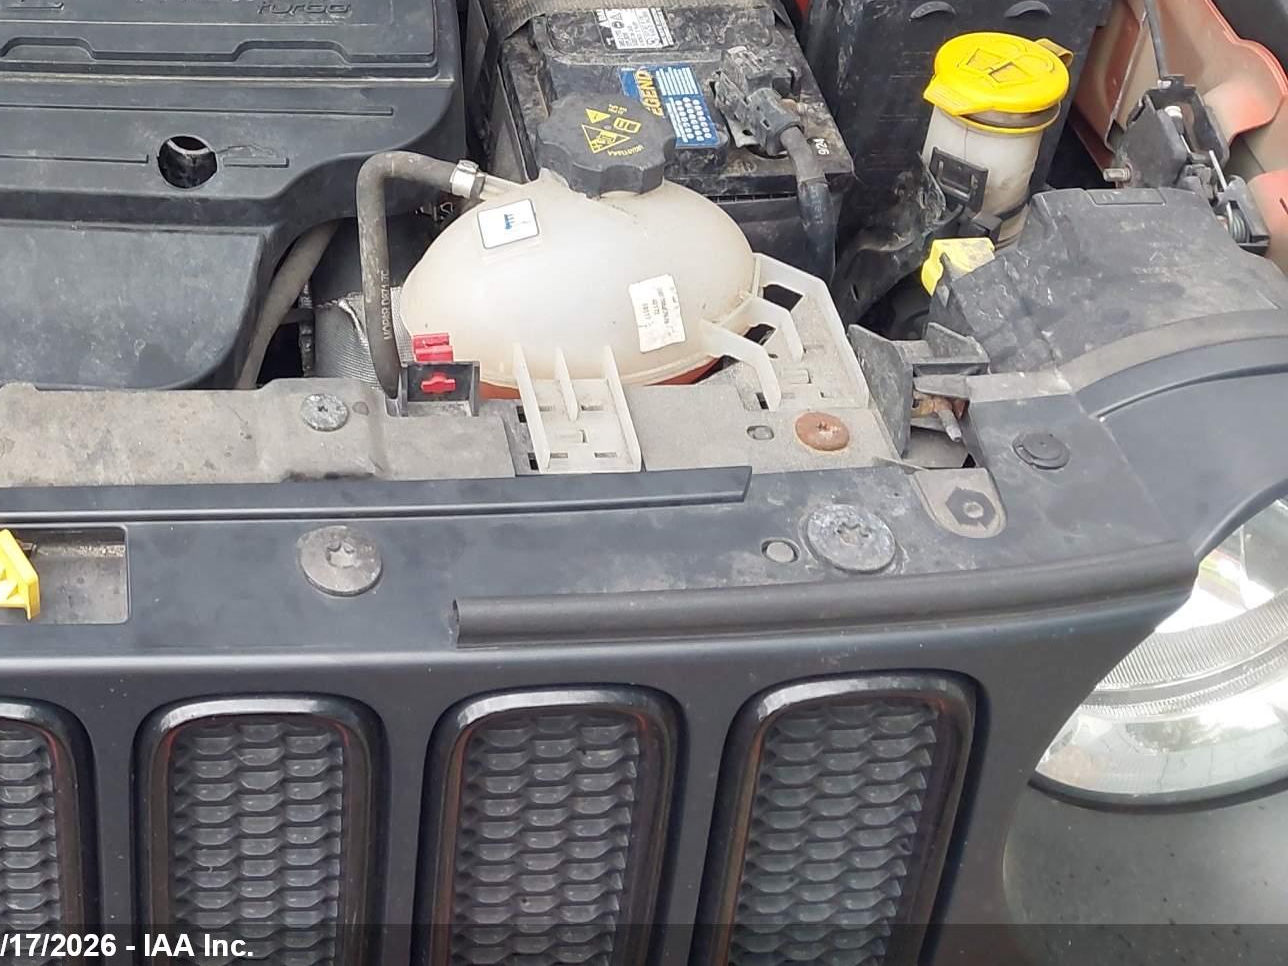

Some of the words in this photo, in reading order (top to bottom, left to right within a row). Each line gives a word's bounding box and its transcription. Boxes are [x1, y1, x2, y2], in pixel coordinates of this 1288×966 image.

[256, 1, 352, 15] turbo
[634, 64, 665, 118] EGEND
[812, 137, 830, 156] 924
